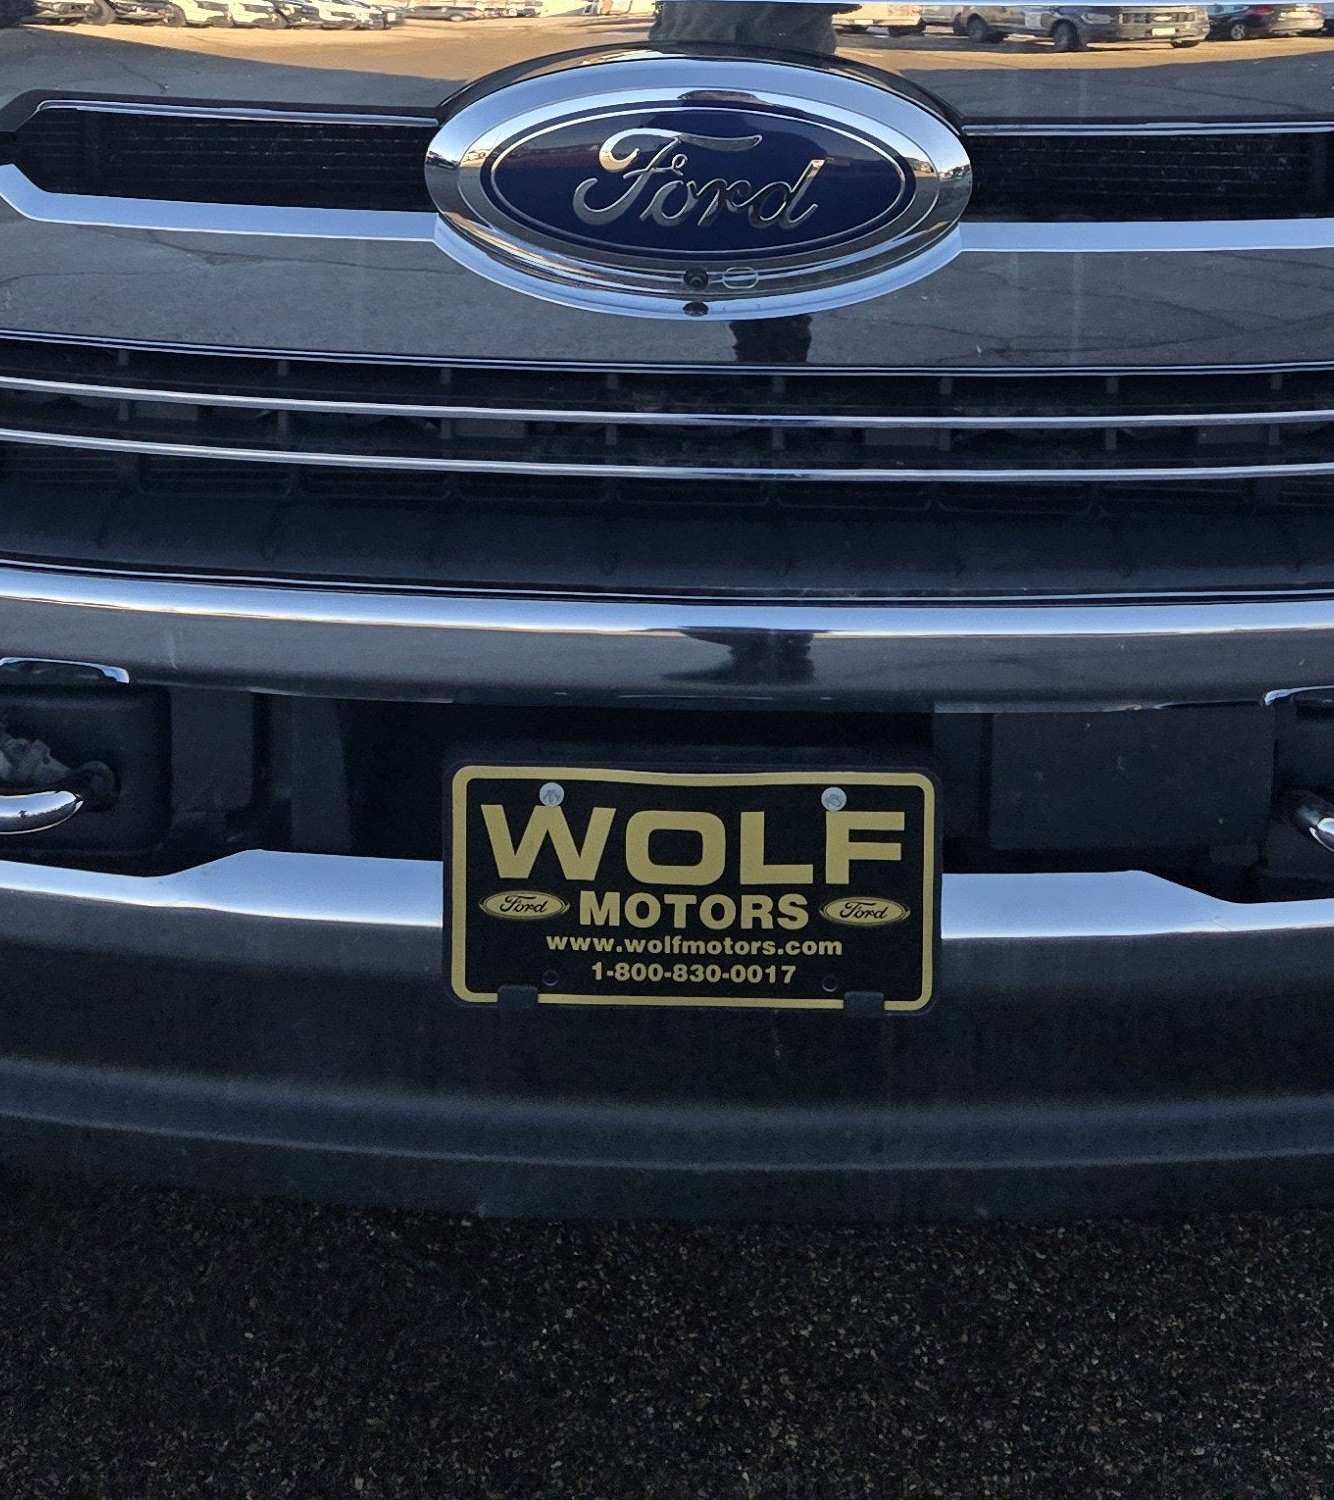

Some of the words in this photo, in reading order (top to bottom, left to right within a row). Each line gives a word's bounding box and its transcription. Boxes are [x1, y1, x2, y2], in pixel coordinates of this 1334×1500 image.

[572, 127, 825, 229] Ford
[480, 804, 906, 886] WOLF
[499, 895, 549, 914] Ford
[579, 890, 809, 930] MOTORS
[839, 901, 889, 920] Ford
[546, 935, 843, 956] www.wolfmotors.com
[591, 962, 796, 984] 1-800-830-0017
